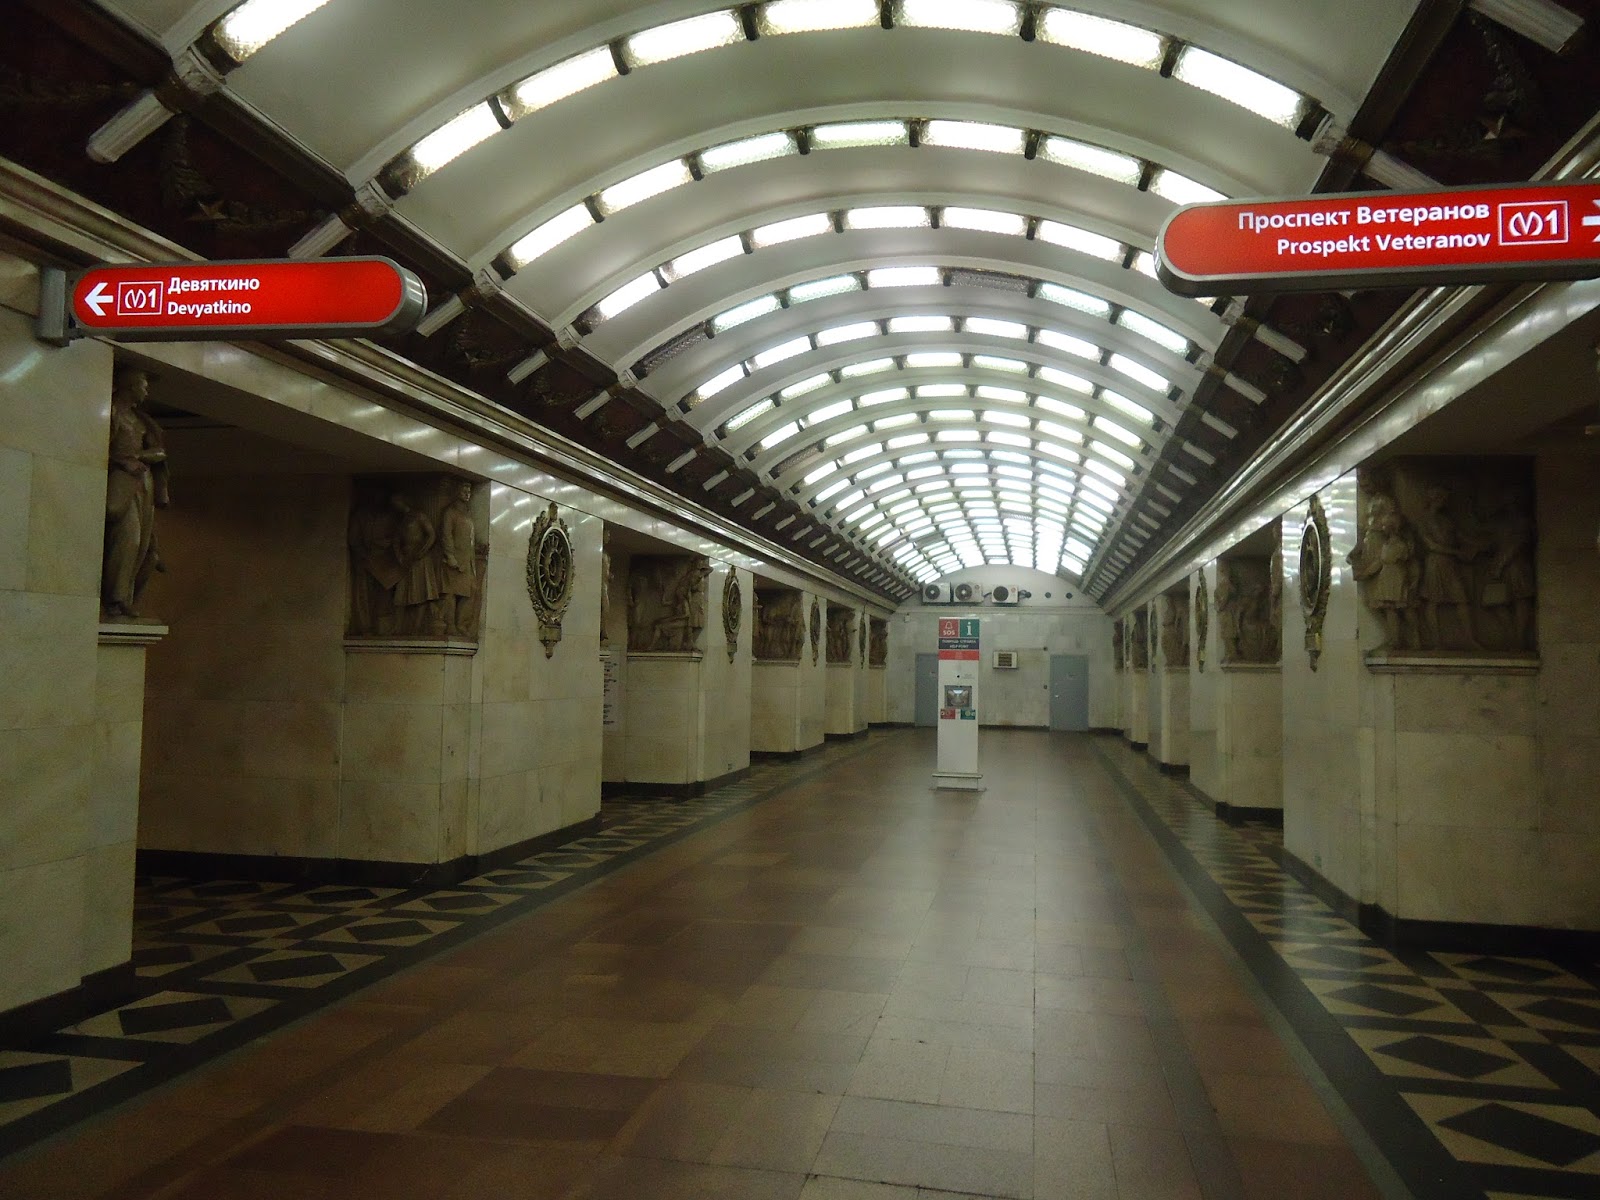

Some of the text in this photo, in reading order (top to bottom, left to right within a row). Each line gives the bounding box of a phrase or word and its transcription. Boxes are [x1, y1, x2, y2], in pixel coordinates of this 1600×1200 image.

[1238, 204, 1490, 234] Проспект Ветеранов
[1277, 233, 1491, 258] Prospekt Veteranov
[167, 277, 260, 295] Девяткино
[167, 299, 252, 318] Devyatkino
